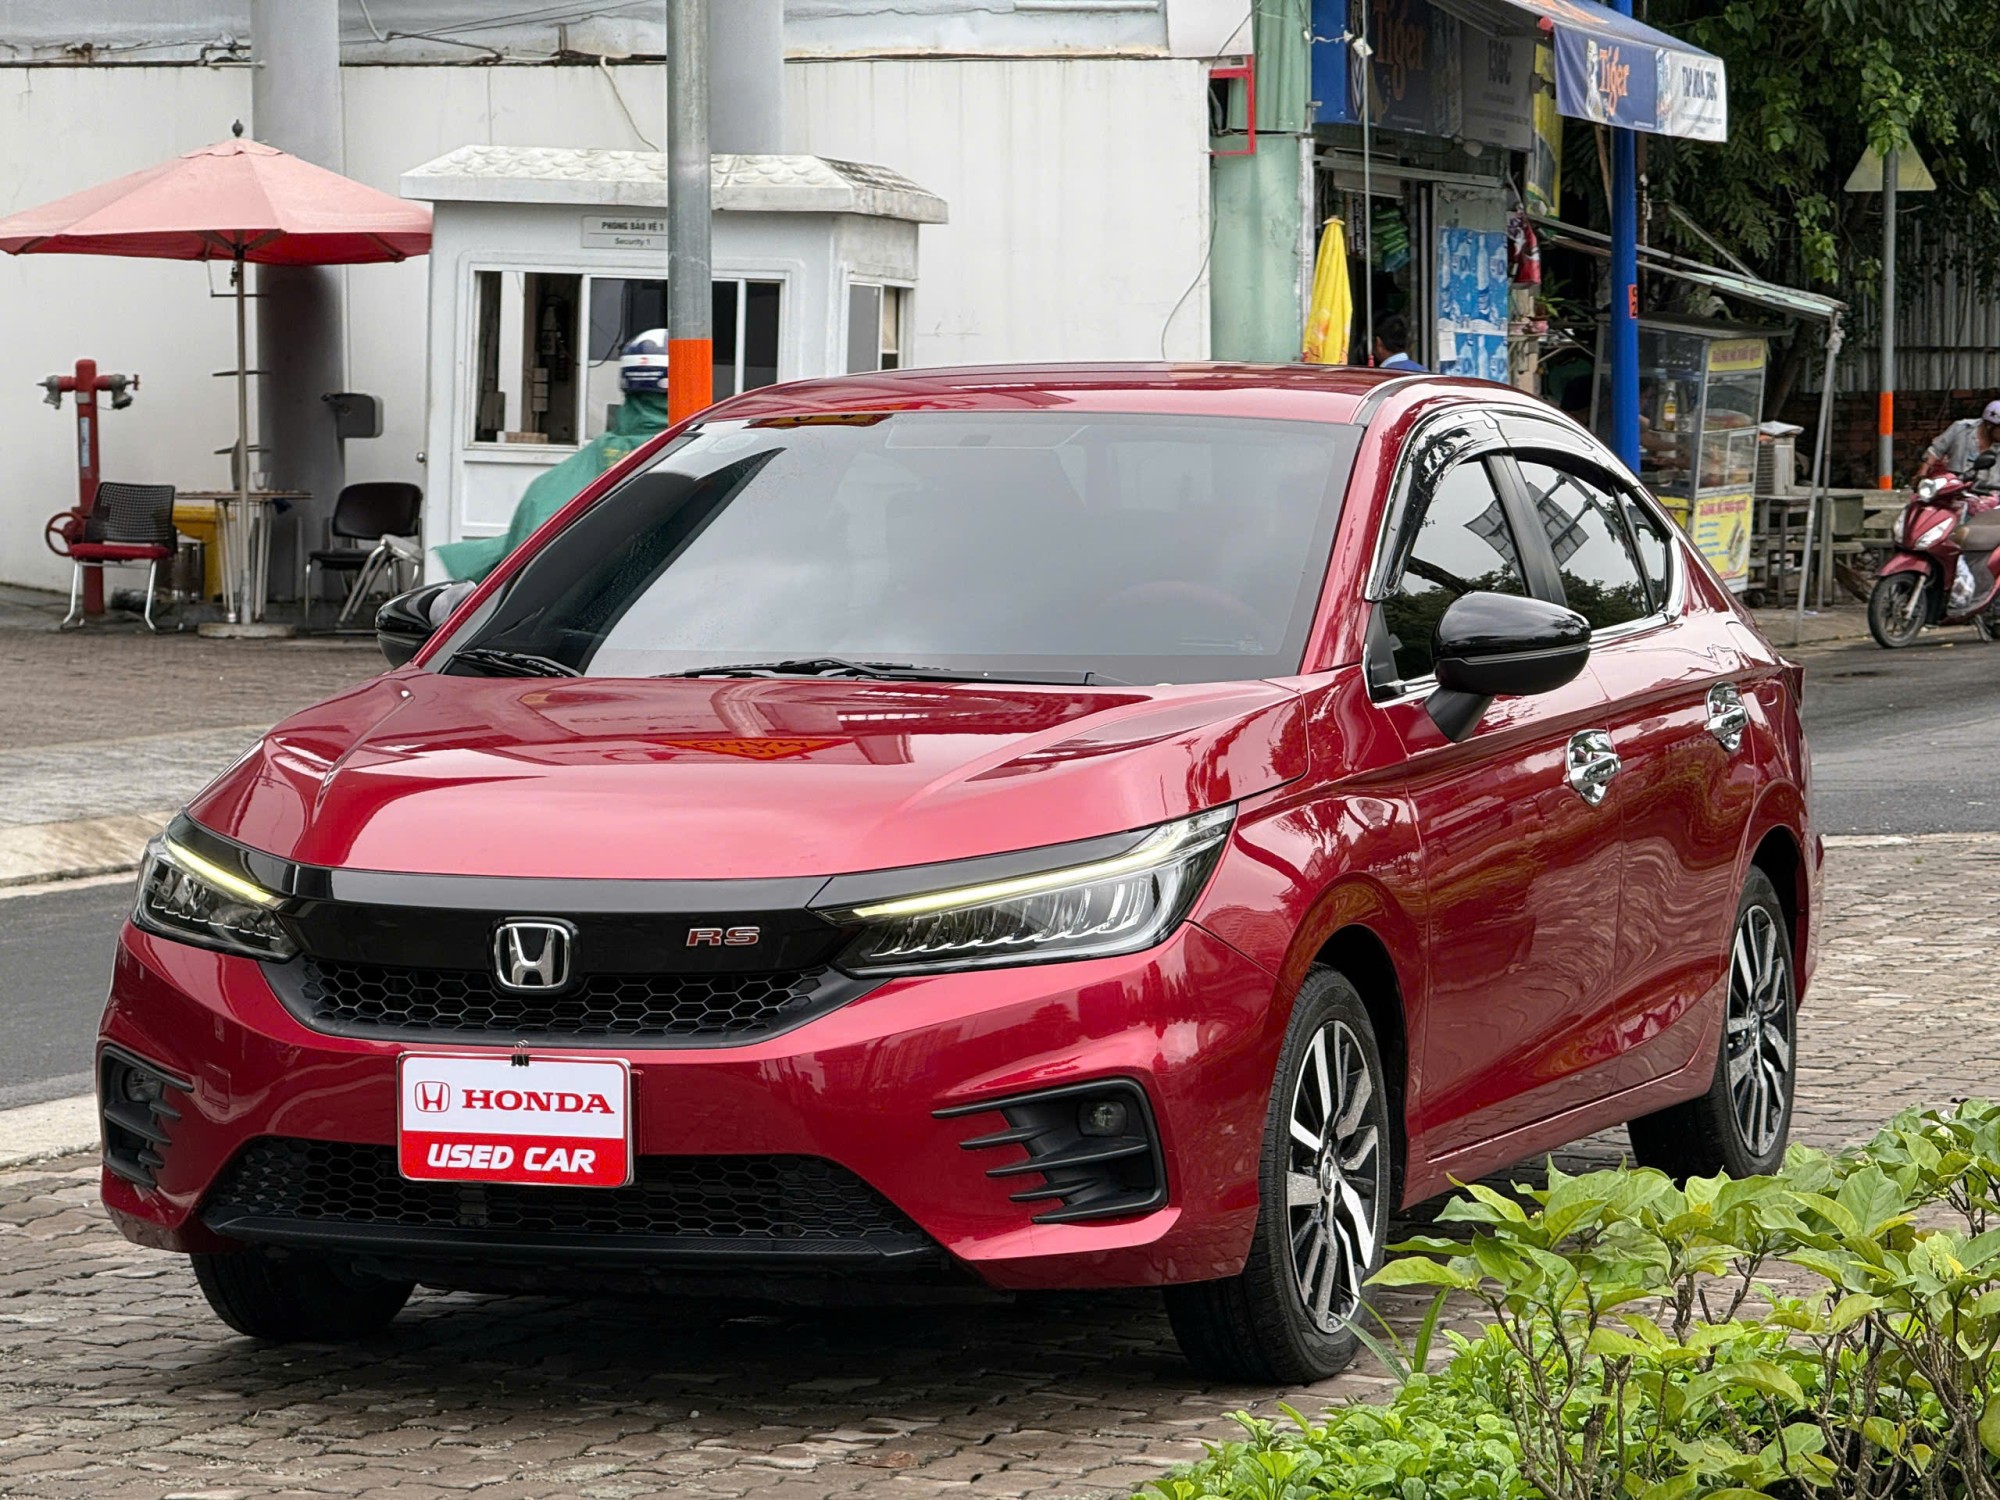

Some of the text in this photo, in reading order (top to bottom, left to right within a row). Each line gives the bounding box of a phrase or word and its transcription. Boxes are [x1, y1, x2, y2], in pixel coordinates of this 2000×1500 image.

[1598, 46, 1630, 116] Tiger
[615, 236, 644, 247] Security
[686, 926, 760, 947] RS
[462, 1089, 615, 1114] HONDA
[427, 1143, 596, 1174] USED CAR
